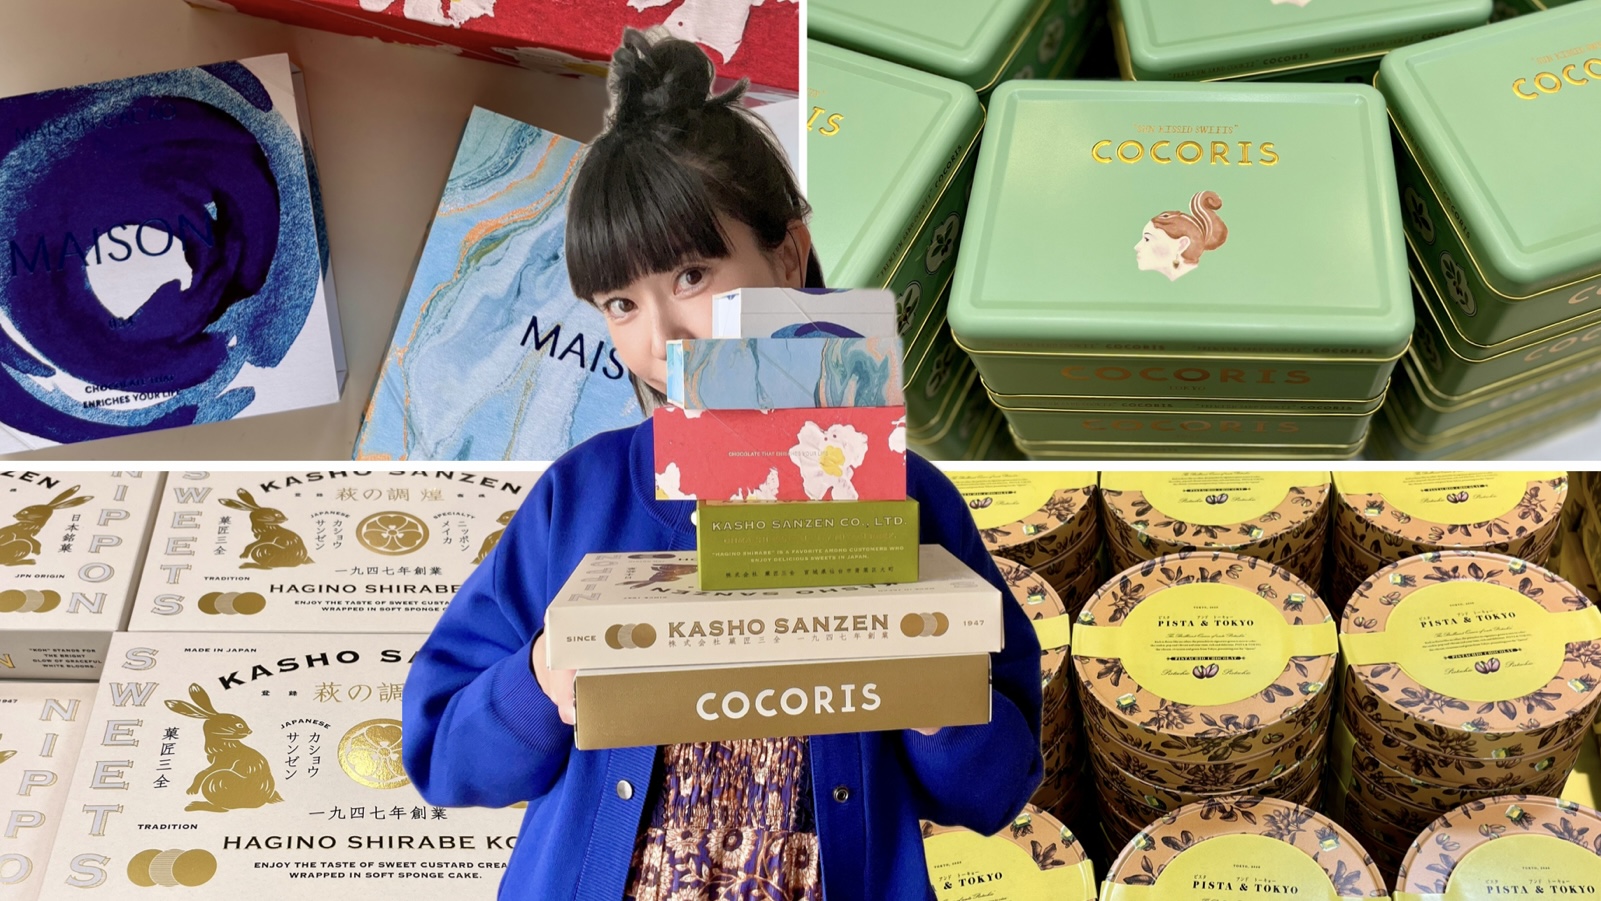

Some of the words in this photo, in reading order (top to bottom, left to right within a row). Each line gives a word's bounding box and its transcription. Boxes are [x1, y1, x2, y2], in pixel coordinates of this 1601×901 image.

[1263, 52, 1310, 66] COCORIS
[1091, 139, 1280, 166] COCORIS
[934, 144, 962, 188] COCORIS
[9, 206, 214, 276] MAISON
[1060, 365, 1311, 385] COCORIS
[83, 395, 131, 409] ENRICHES
[132, 391, 160, 402] YOUR
[1081, 419, 1299, 433] COCORIS
[433, 511, 475, 519] SPECIALTY
[712, 520, 766, 531] KASHO
[772, 518, 834, 529] SANZEN
[875, 517, 907, 526] LTD.
[213, 516, 232, 555] 菓匠三全
[315, 520, 327, 550] サンゼン
[442, 521, 452, 544] メイカ
[334, 566, 443, 576] 一九四七年創業
[269, 584, 357, 594] HAGINO
[668, 618, 765, 638] KASHO
[774, 613, 889, 634] SANZEN
[1214, 619, 1254, 627] TOKYO
[1420, 618, 1458, 628] PISTA
[1475, 611, 1516, 622] TOKYO
[566, 635, 597, 643] SINCE
[218, 650, 360, 690] KASHO
[696, 683, 881, 721] COCORIS
[281, 718, 331, 730] JAPANESE
[153, 727, 180, 789] 菓匠三全
[285, 732, 299, 780] サンゼン
[307, 732, 321, 778] カショウ
[64, 647, 159, 889] SWEETS
[309, 806, 448, 820] 一九四七年創業
[223, 836, 336, 849] HAGINO
[347, 836, 475, 849] SHIRABE
[943, 882, 952, 890] &
[958, 872, 1002, 887] TOKYO
[1192, 881, 1233, 891] PISTA
[1239, 883, 1248, 892] &
[1254, 884, 1298, 894] TOKYO
[1486, 885, 1529, 894] PISTA
[1535, 885, 1544, 894] &
[1550, 885, 1595, 894] TOKYO
